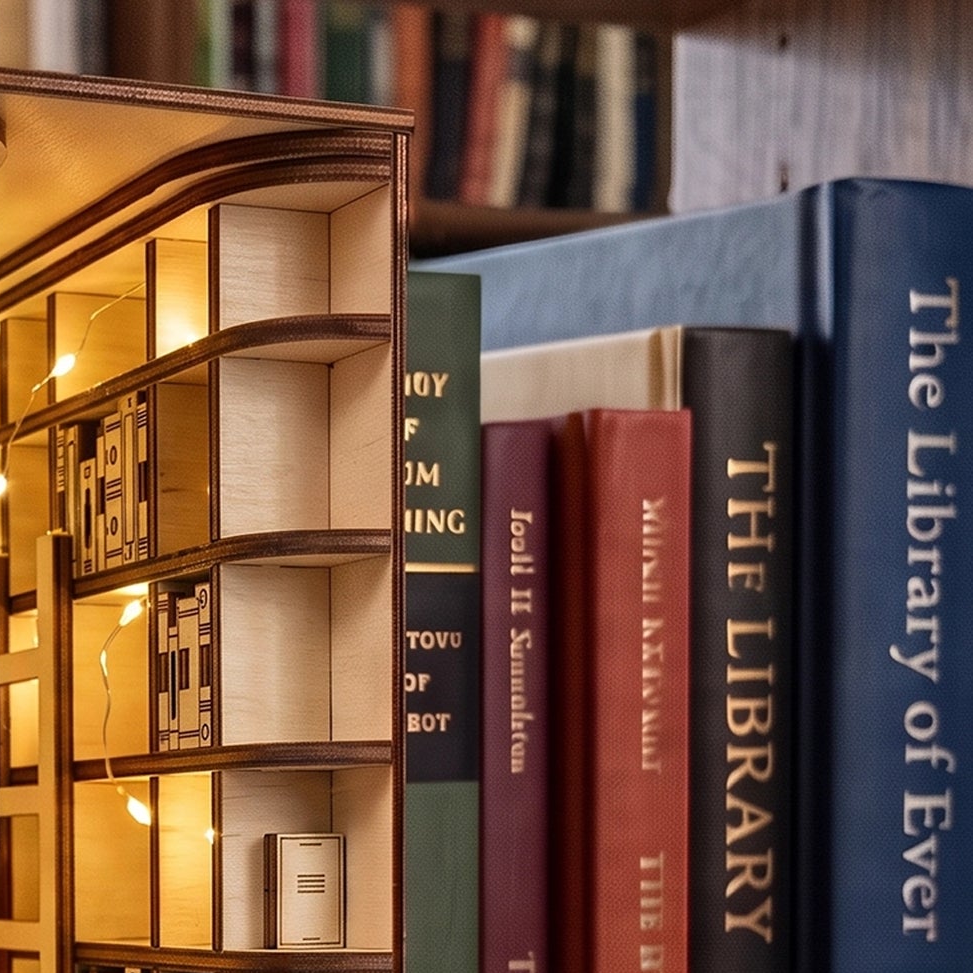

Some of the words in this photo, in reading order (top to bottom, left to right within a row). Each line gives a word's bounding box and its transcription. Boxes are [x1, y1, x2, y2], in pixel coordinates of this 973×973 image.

[909, 278, 958, 407] The
[889, 430, 957, 682] Library
[726, 617, 774, 942] LIBRARY
[904, 701, 954, 774] of
[903, 790, 951, 942] Ever
